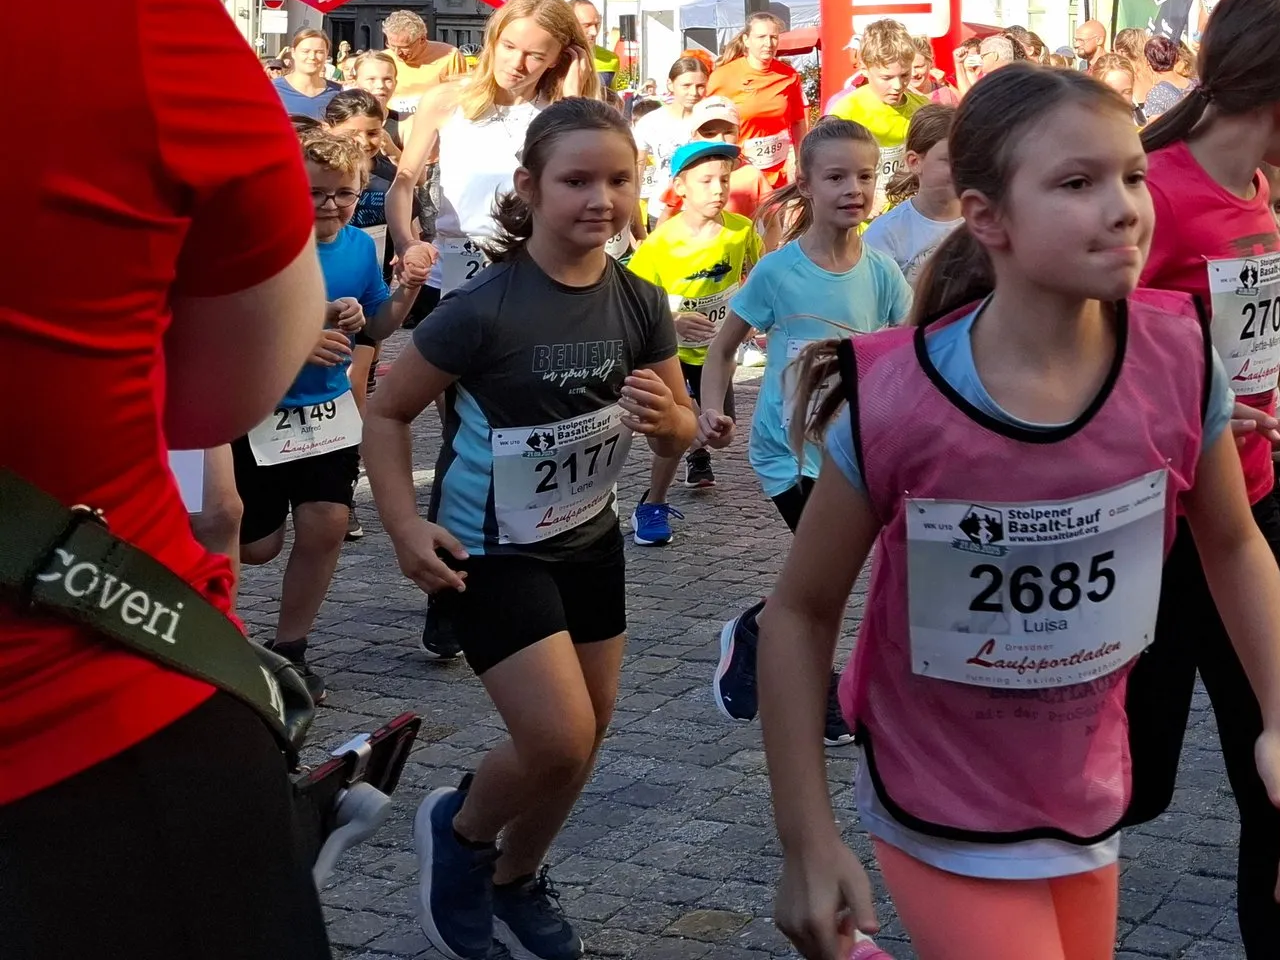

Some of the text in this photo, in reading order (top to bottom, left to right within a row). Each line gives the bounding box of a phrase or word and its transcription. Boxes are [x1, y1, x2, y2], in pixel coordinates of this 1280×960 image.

[756, 142, 783, 157] 2489
[702, 306, 726, 323] 08
[532, 340, 623, 372] BELIEVE
[542, 358, 616, 387] in your self
[568, 386, 587, 395] ACTIVE
[274, 400, 336, 431] 2149
[557, 417, 596, 431] Stolpener
[301, 425, 322, 435] Alfred
[557, 415, 611, 440] Basalt-Lauf
[534, 433, 620, 494] 2177
[571, 480, 594, 495] Lene
[1008, 506, 1074, 521] Stolpener
[1008, 508, 1102, 533] Basalt-Lauf
[1009, 524, 1099, 542] www.basaltlauf.org
[969, 550, 1116, 614] 2685
[1023, 619, 1068, 633] Luisa
[1005, 642, 1054, 651] Dresdner
[966, 638, 1122, 675] Laufsportladen
[965, 673, 1010, 685] running
[1027, 674, 1063, 685] skiing
